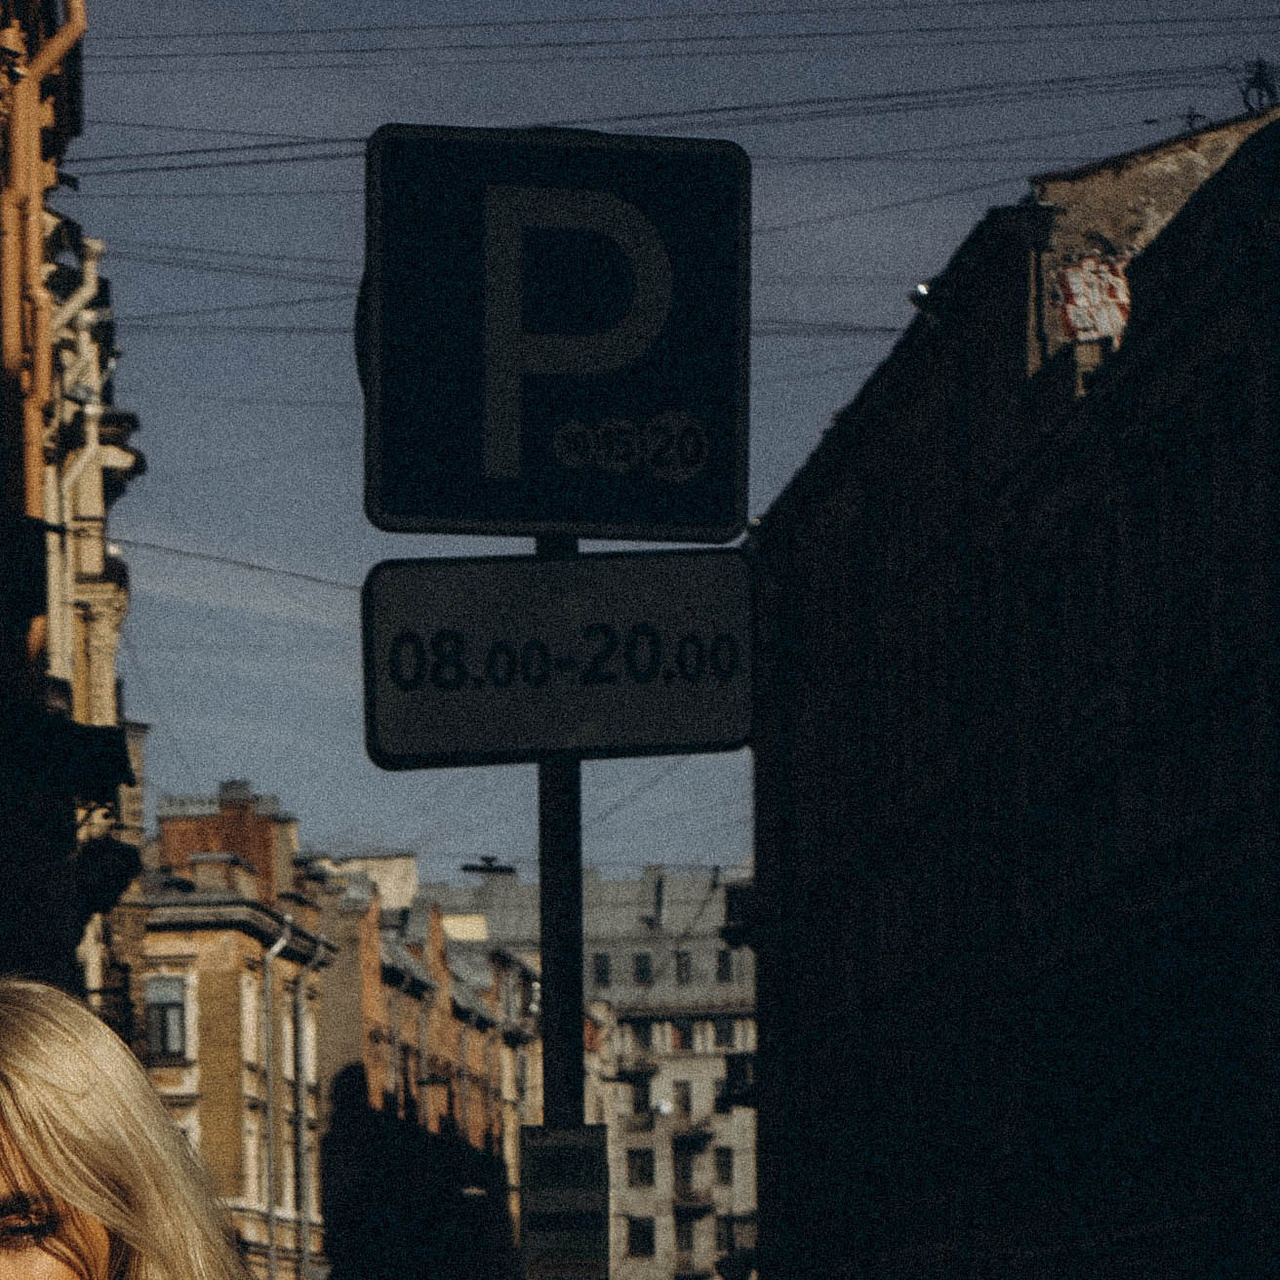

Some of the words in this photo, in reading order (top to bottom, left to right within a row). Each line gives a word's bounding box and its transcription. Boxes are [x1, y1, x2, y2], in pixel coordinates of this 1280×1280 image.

[483, 184, 673, 479] P
[650, 424, 705, 468] 20
[388, 621, 740, 692] 08.00-20.00
